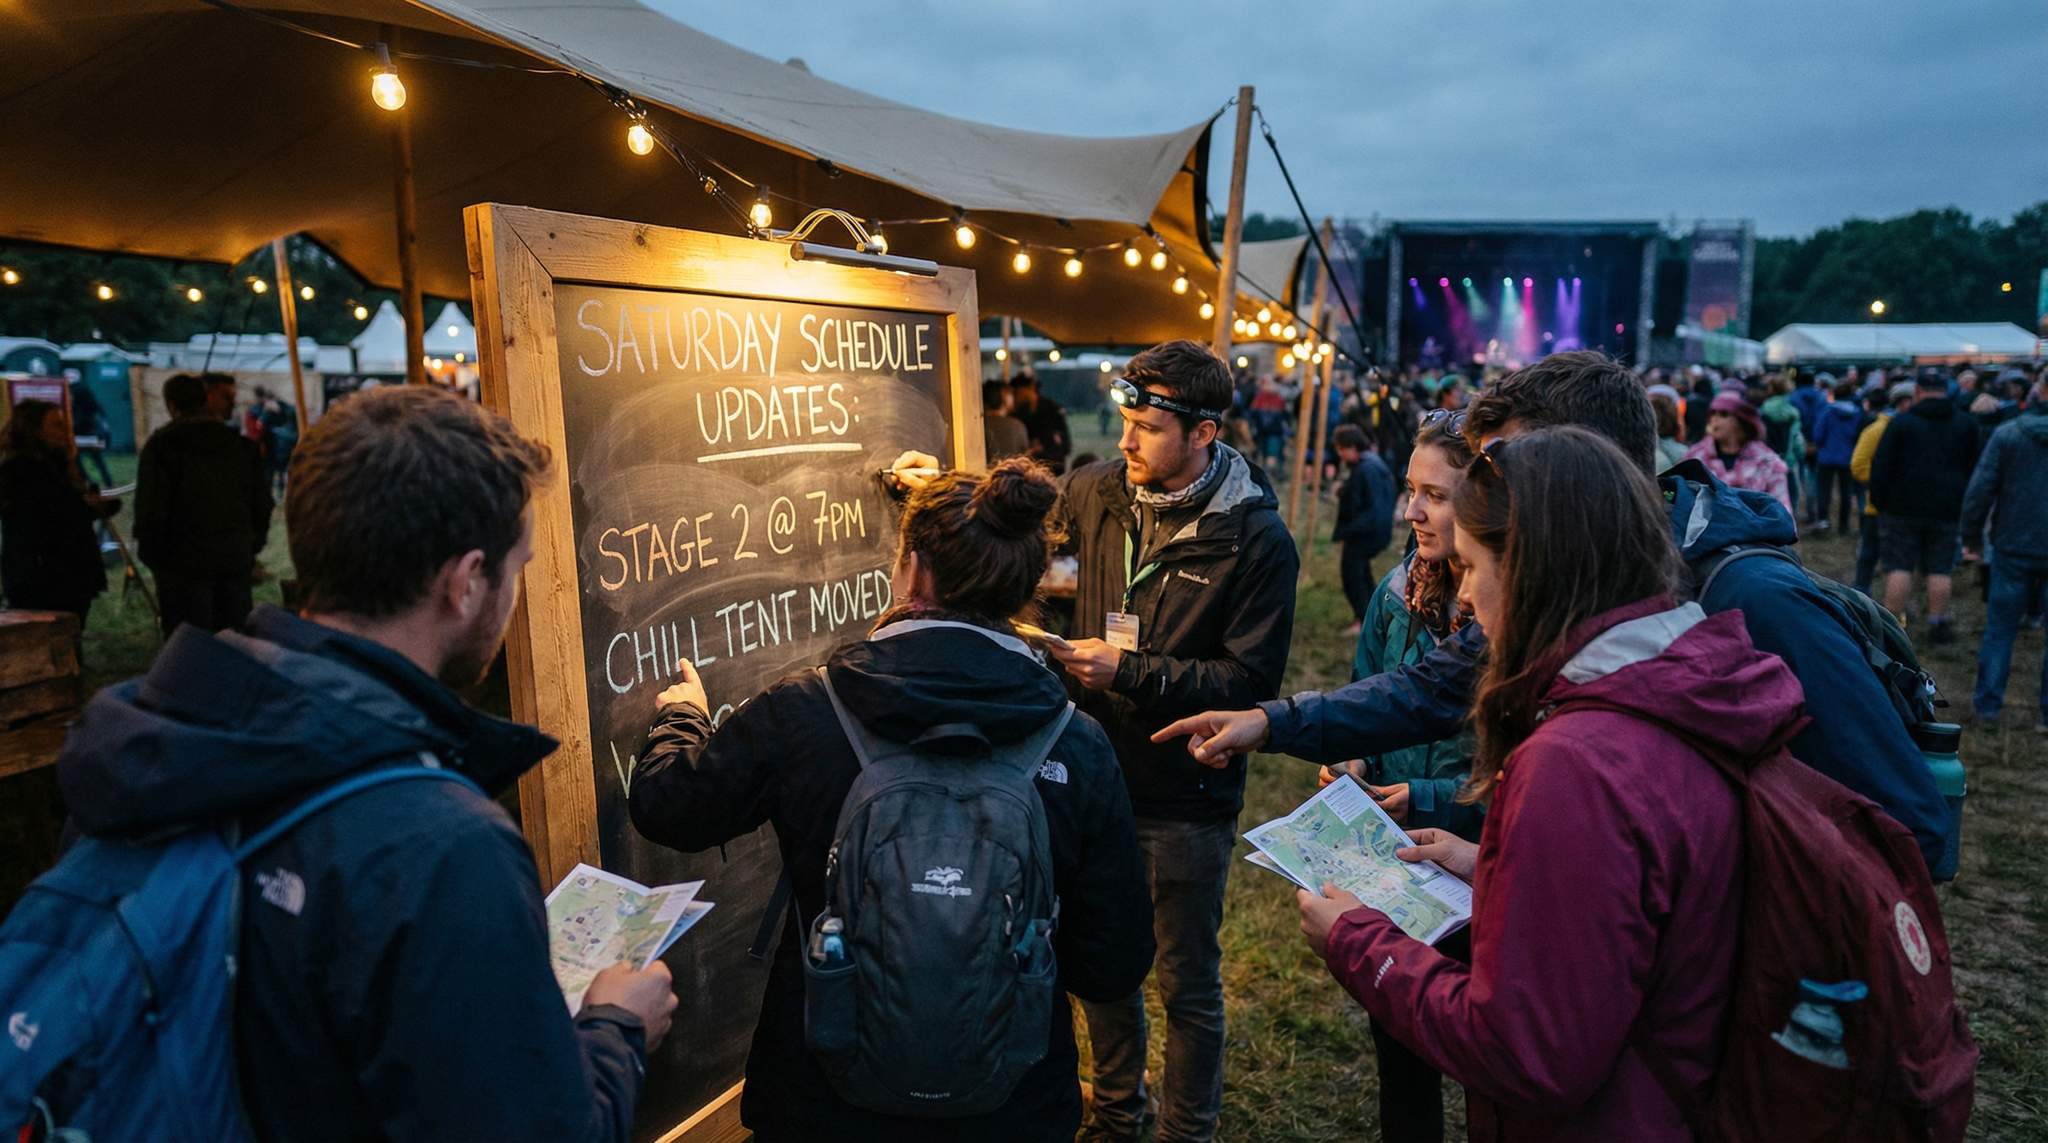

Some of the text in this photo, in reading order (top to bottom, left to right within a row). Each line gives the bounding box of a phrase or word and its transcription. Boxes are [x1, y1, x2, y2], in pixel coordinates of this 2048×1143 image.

[577, 299, 933, 379] SATURDAY SCHEDULE
[696, 382, 859, 445] UPDATES:
[599, 490, 866, 591] STAGE 2 @ 7PM
[606, 569, 892, 694] CHILL TENT MOVED
